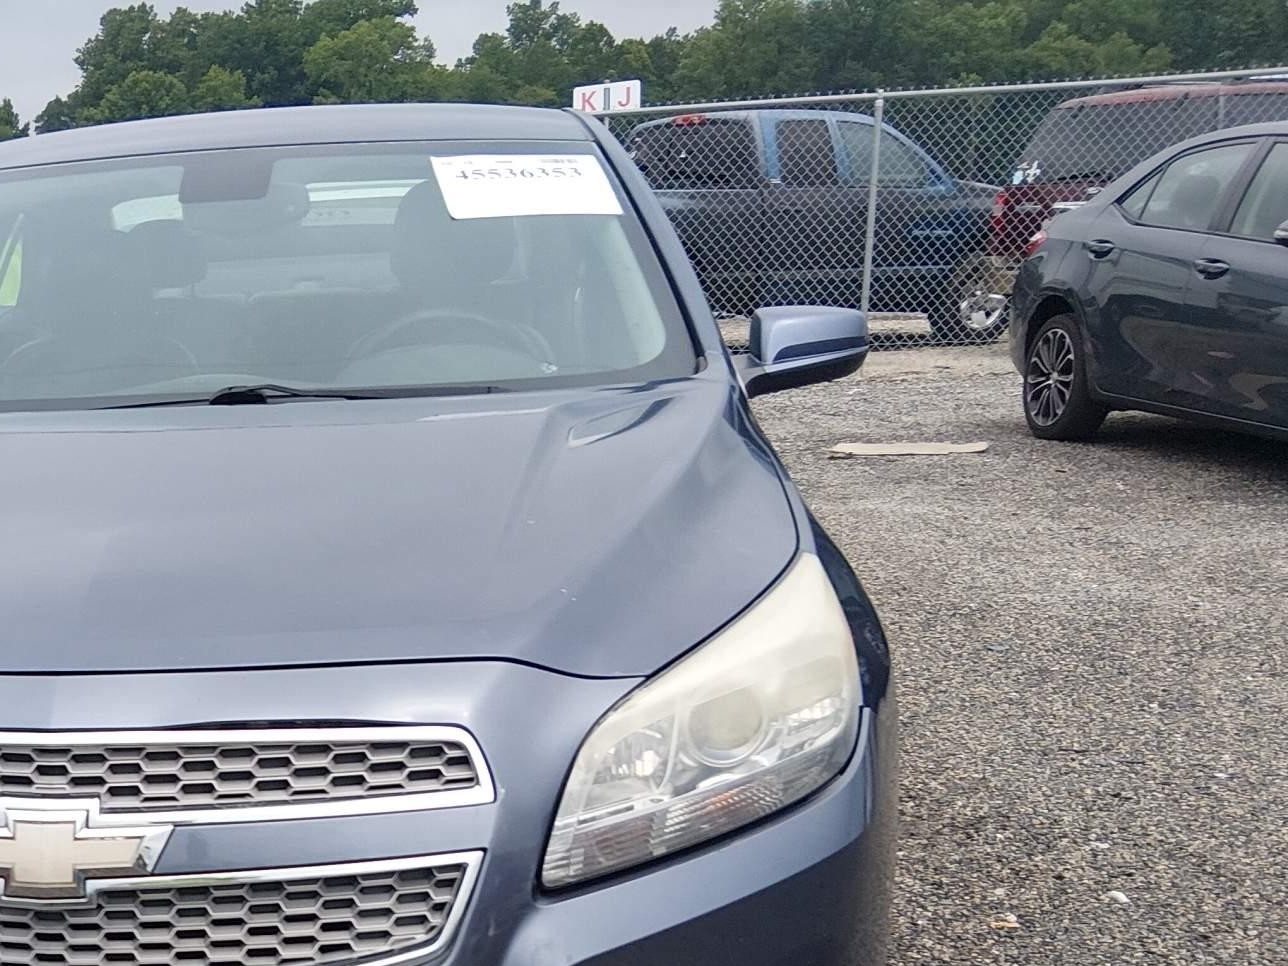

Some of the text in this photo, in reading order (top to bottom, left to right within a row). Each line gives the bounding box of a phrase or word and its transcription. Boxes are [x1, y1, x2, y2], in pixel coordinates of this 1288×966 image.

[581, 86, 631, 111] K J
[456, 167, 583, 181] 45536353
